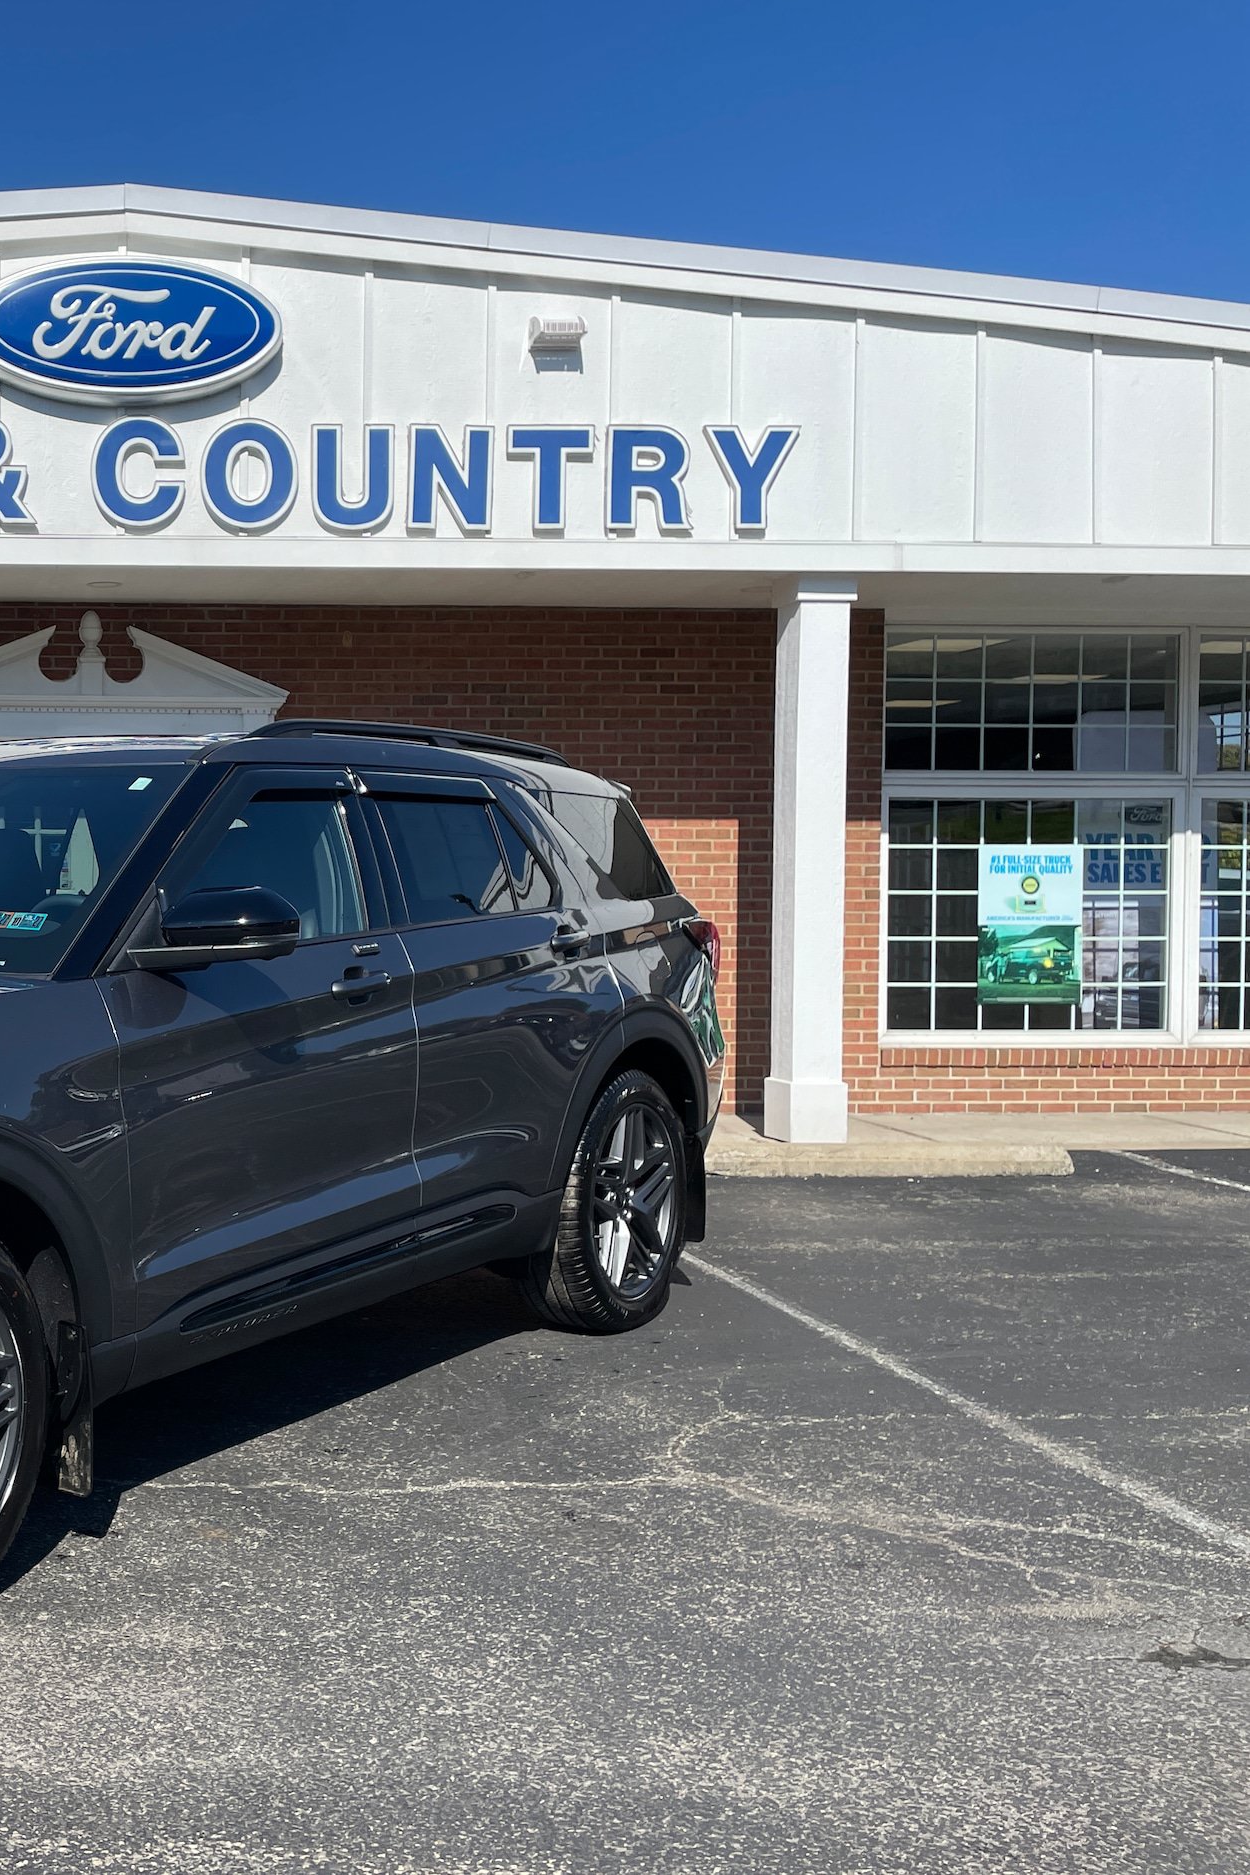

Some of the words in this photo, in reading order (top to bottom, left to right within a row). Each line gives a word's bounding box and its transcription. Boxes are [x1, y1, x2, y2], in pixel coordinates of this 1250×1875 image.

[32, 284, 216, 361] Ford
[90, 414, 801, 531] COUNTRY
[991, 855, 1000, 864] #1
[1003, 855, 1041, 864] FULL-SIZE
[1044, 855, 1071, 864] TRUCK
[1086, 833, 1154, 860] YEAR
[989, 864, 1006, 874] FOR
[1008, 864, 1035, 874] INITIAL
[1039, 864, 1073, 875] QUALITY
